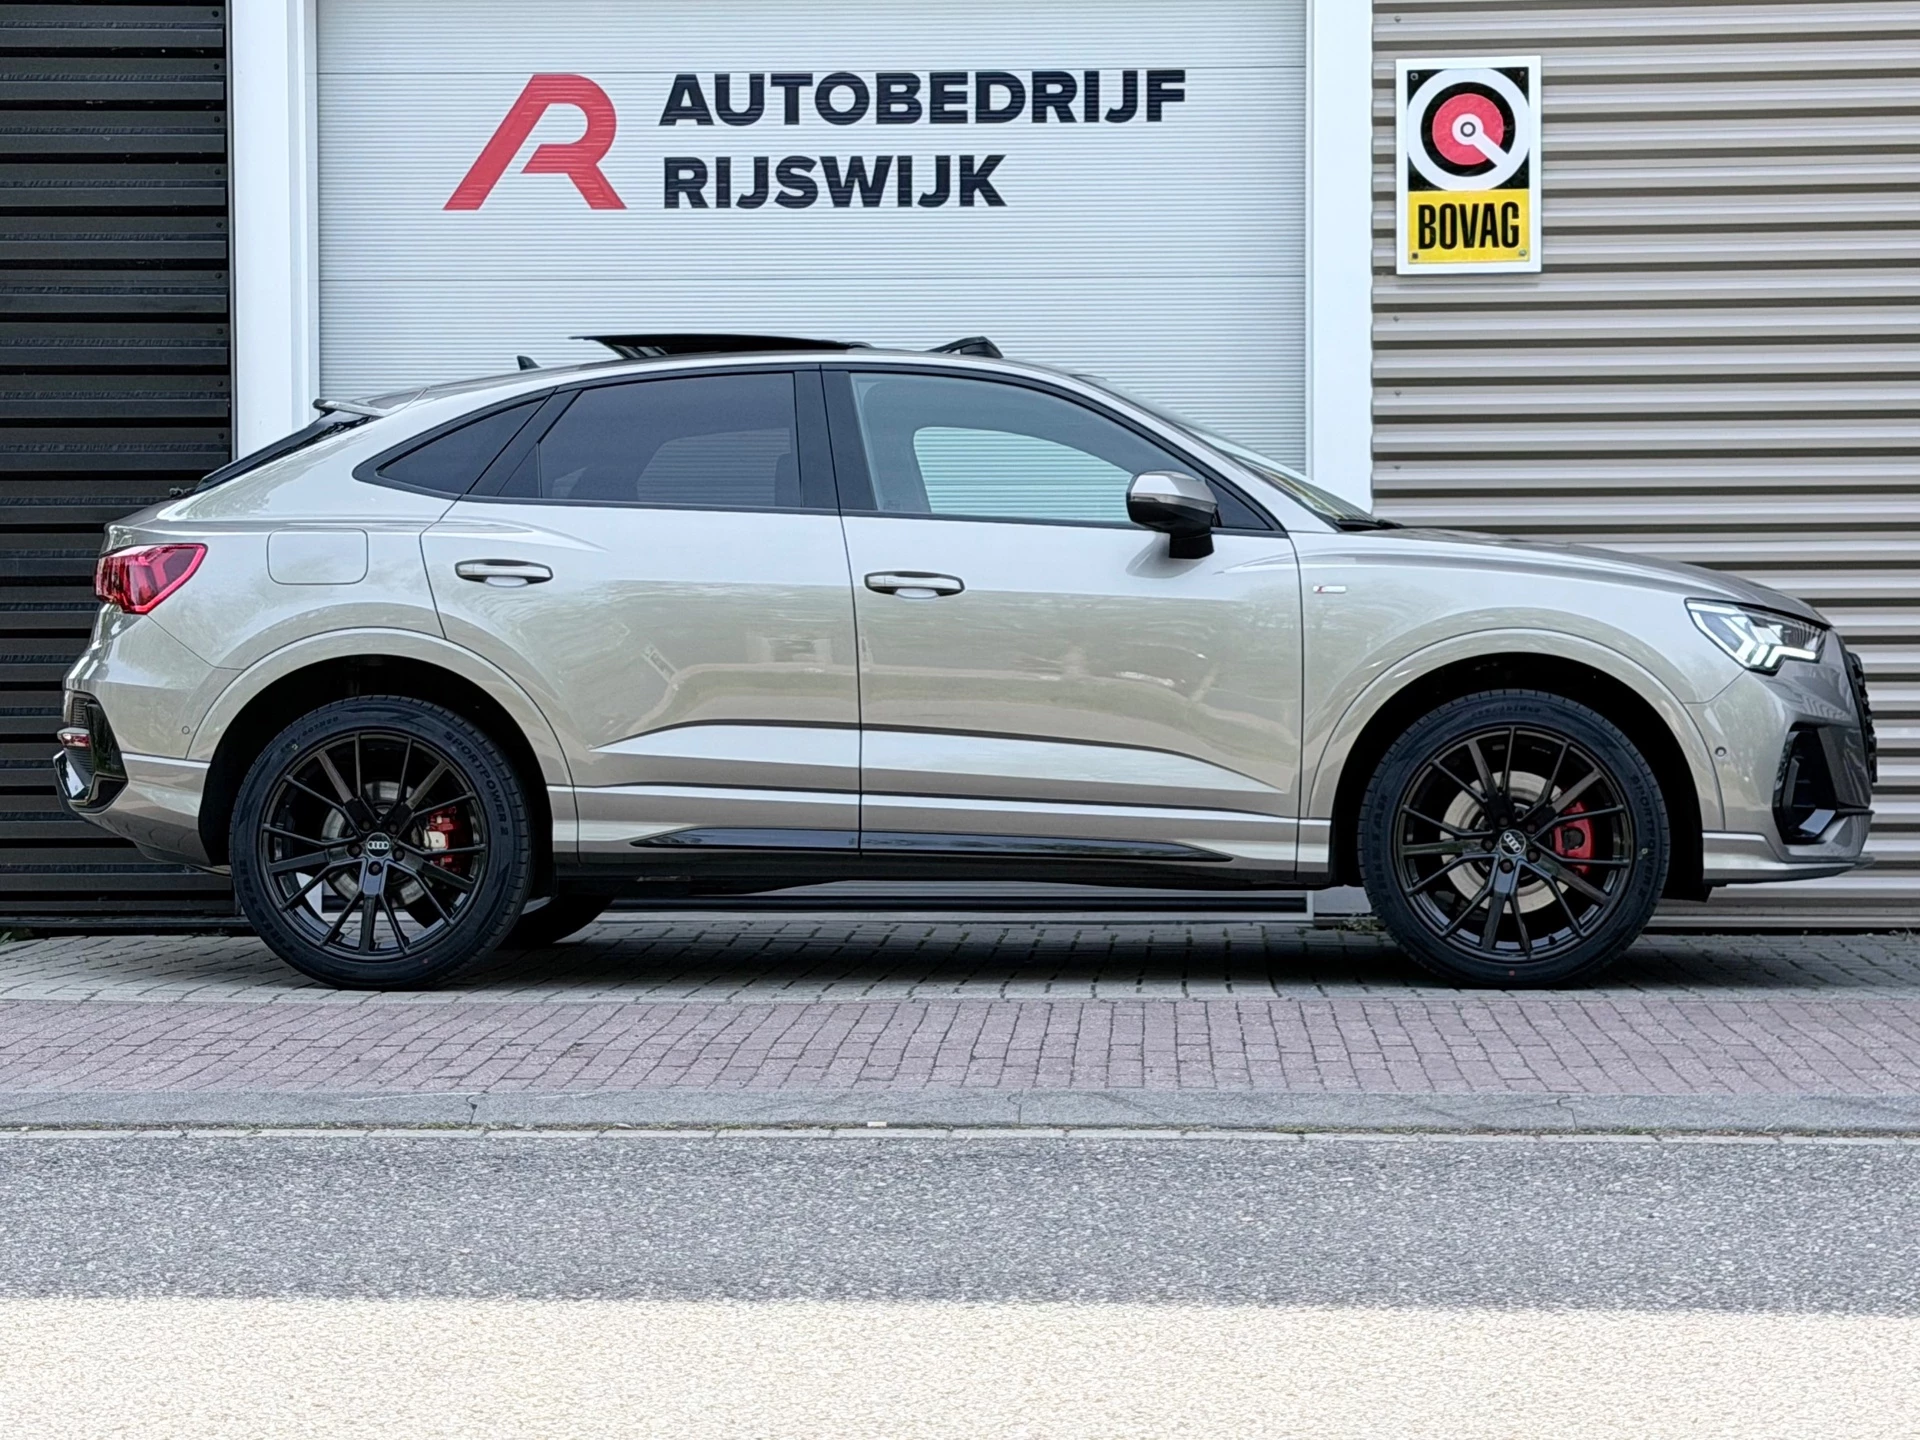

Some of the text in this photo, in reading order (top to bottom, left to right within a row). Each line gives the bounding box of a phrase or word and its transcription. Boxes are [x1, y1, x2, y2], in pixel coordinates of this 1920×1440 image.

[660, 69, 1186, 127] AUTOBEDRIJF
[664, 154, 1006, 209] RIJSWIJK
[1418, 202, 1519, 249] BOVAG
[443, 730, 507, 823] SPORTPOWER
